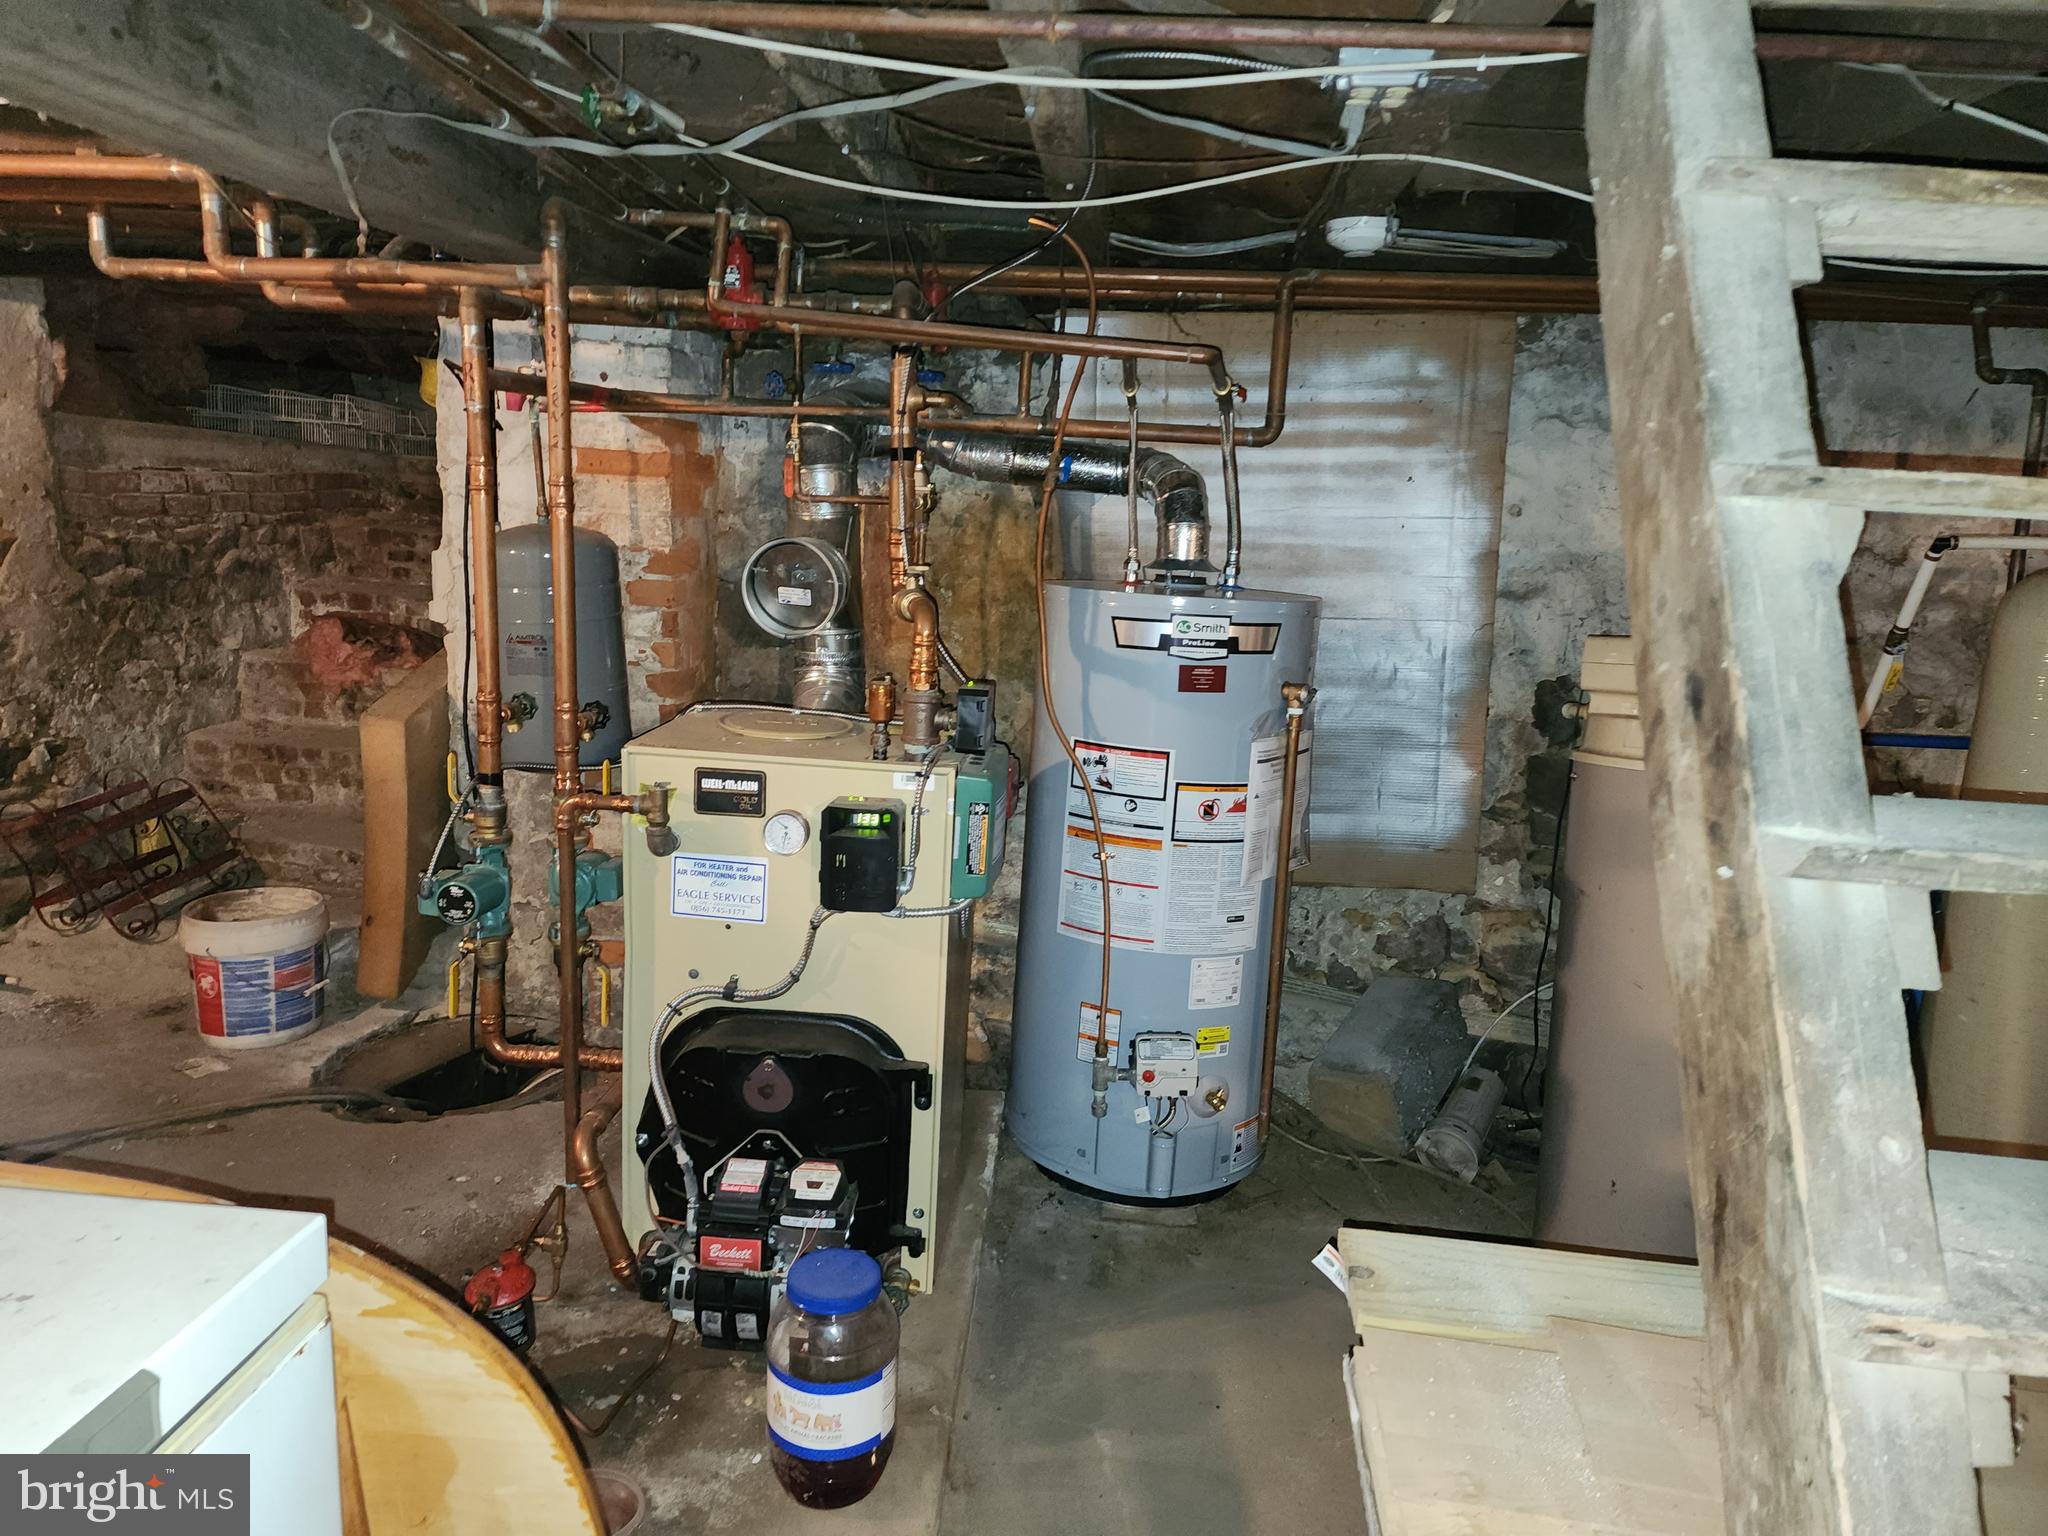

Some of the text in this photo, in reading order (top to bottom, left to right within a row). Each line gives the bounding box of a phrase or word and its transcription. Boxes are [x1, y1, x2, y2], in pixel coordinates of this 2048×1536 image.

[1193, 622, 1226, 634] Smith
[693, 861, 707, 869] FOR
[709, 863, 734, 871] HEATER
[677, 868, 762, 882] AIR CONDITIONING REPAIR
[677, 888, 709, 900] EAGLE
[713, 892, 761, 905] SERVICES
[708, 1243, 753, 1259] Beckett
